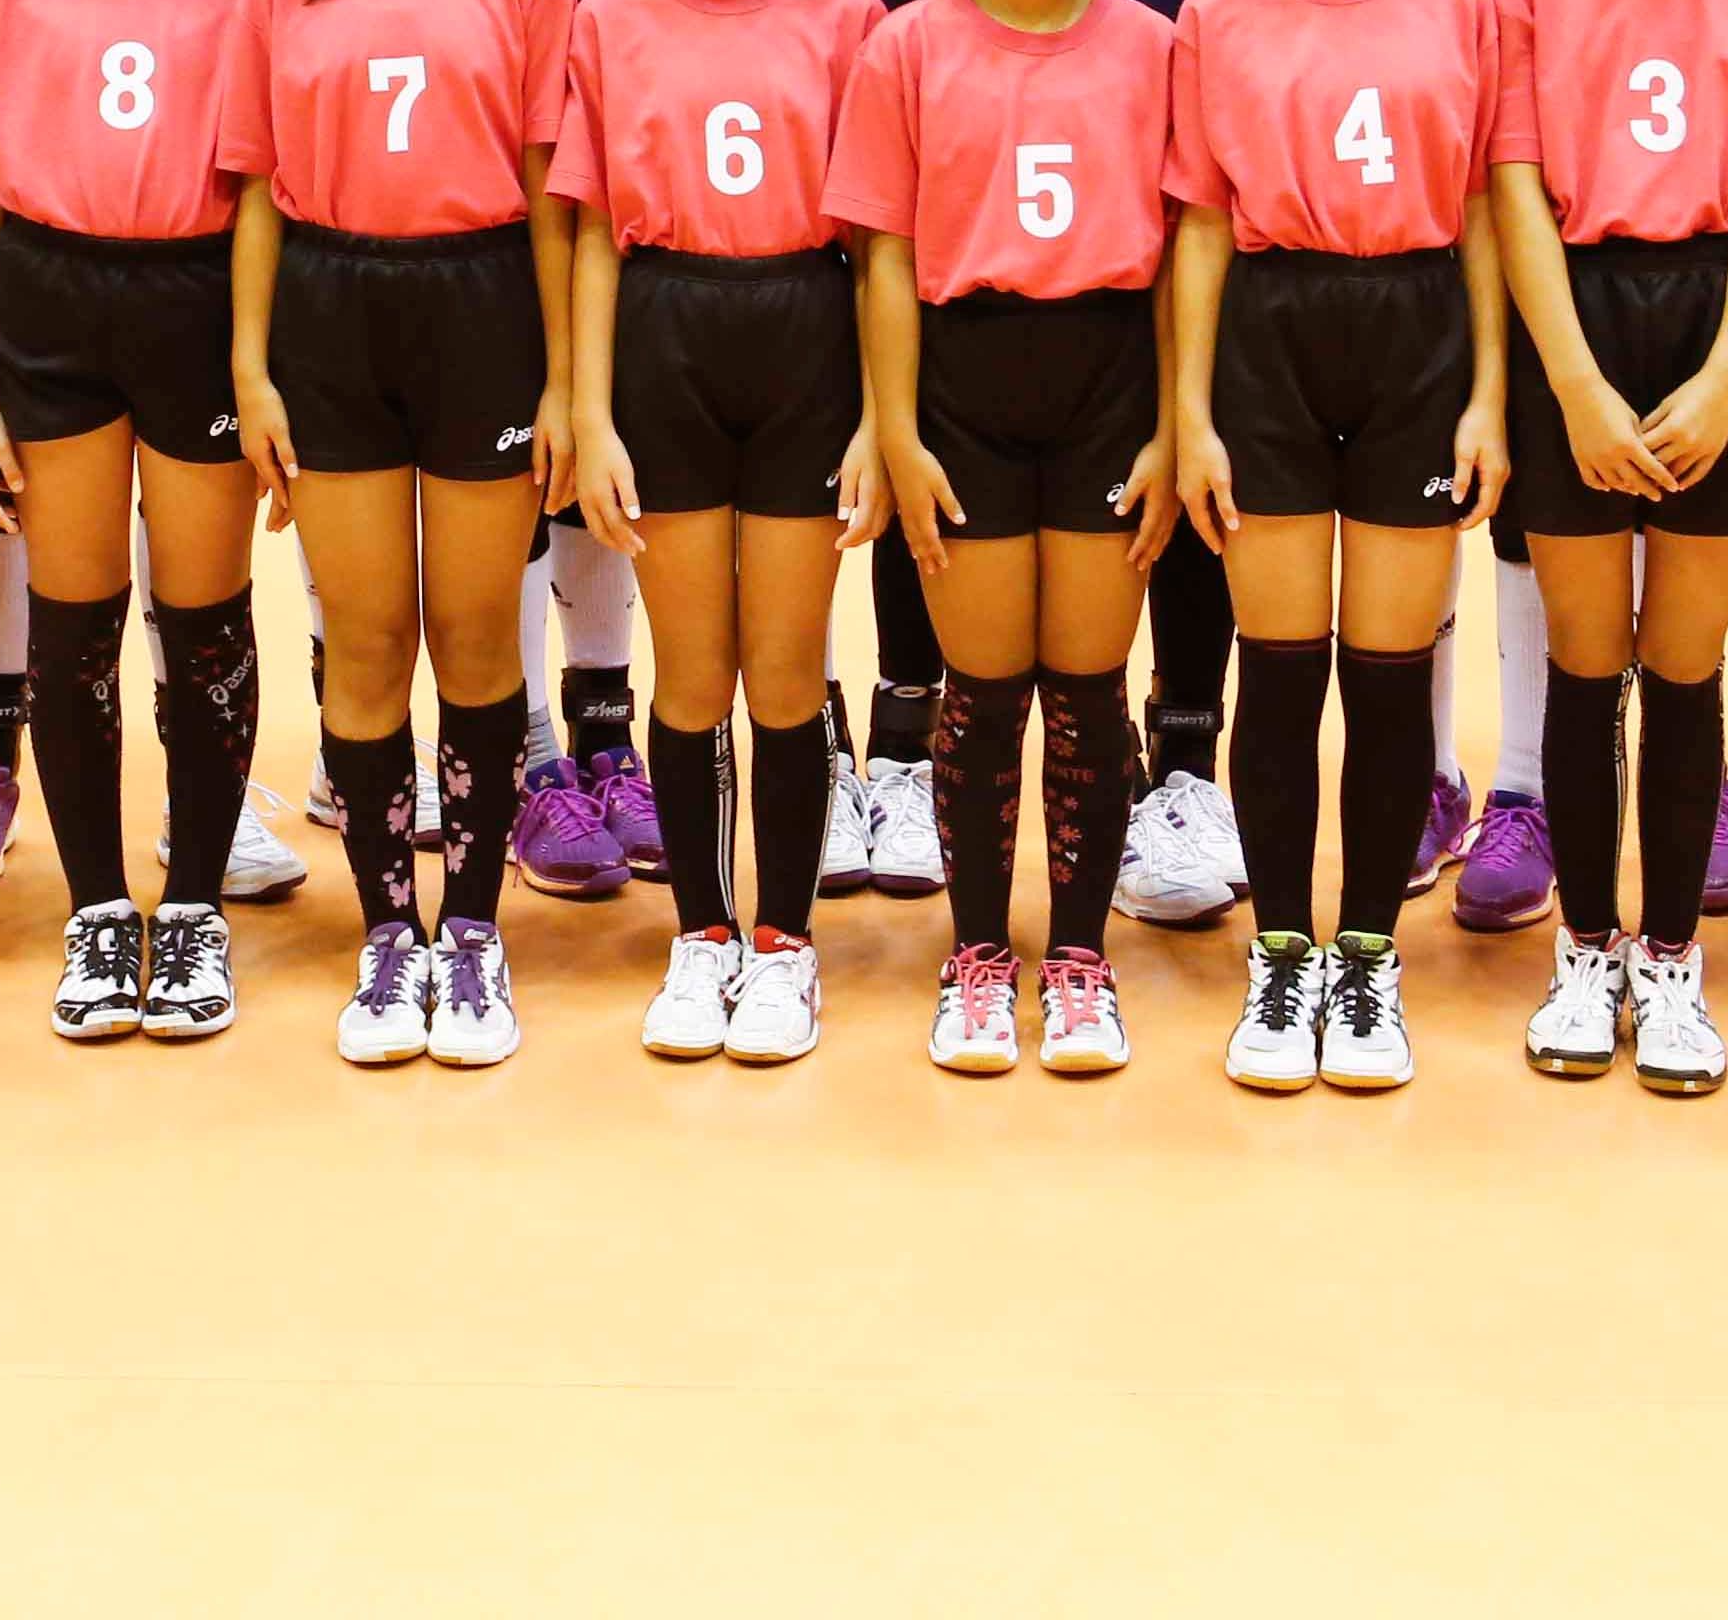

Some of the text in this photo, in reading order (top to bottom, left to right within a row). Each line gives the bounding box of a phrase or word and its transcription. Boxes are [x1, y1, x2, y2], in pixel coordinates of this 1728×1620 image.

[98, 40, 155, 131] 8
[366, 55, 427, 153] 7
[1628, 58, 1687, 153] 3
[703, 99, 765, 196] 6
[1333, 87, 1396, 185] 4
[1014, 142, 1074, 240] 5
